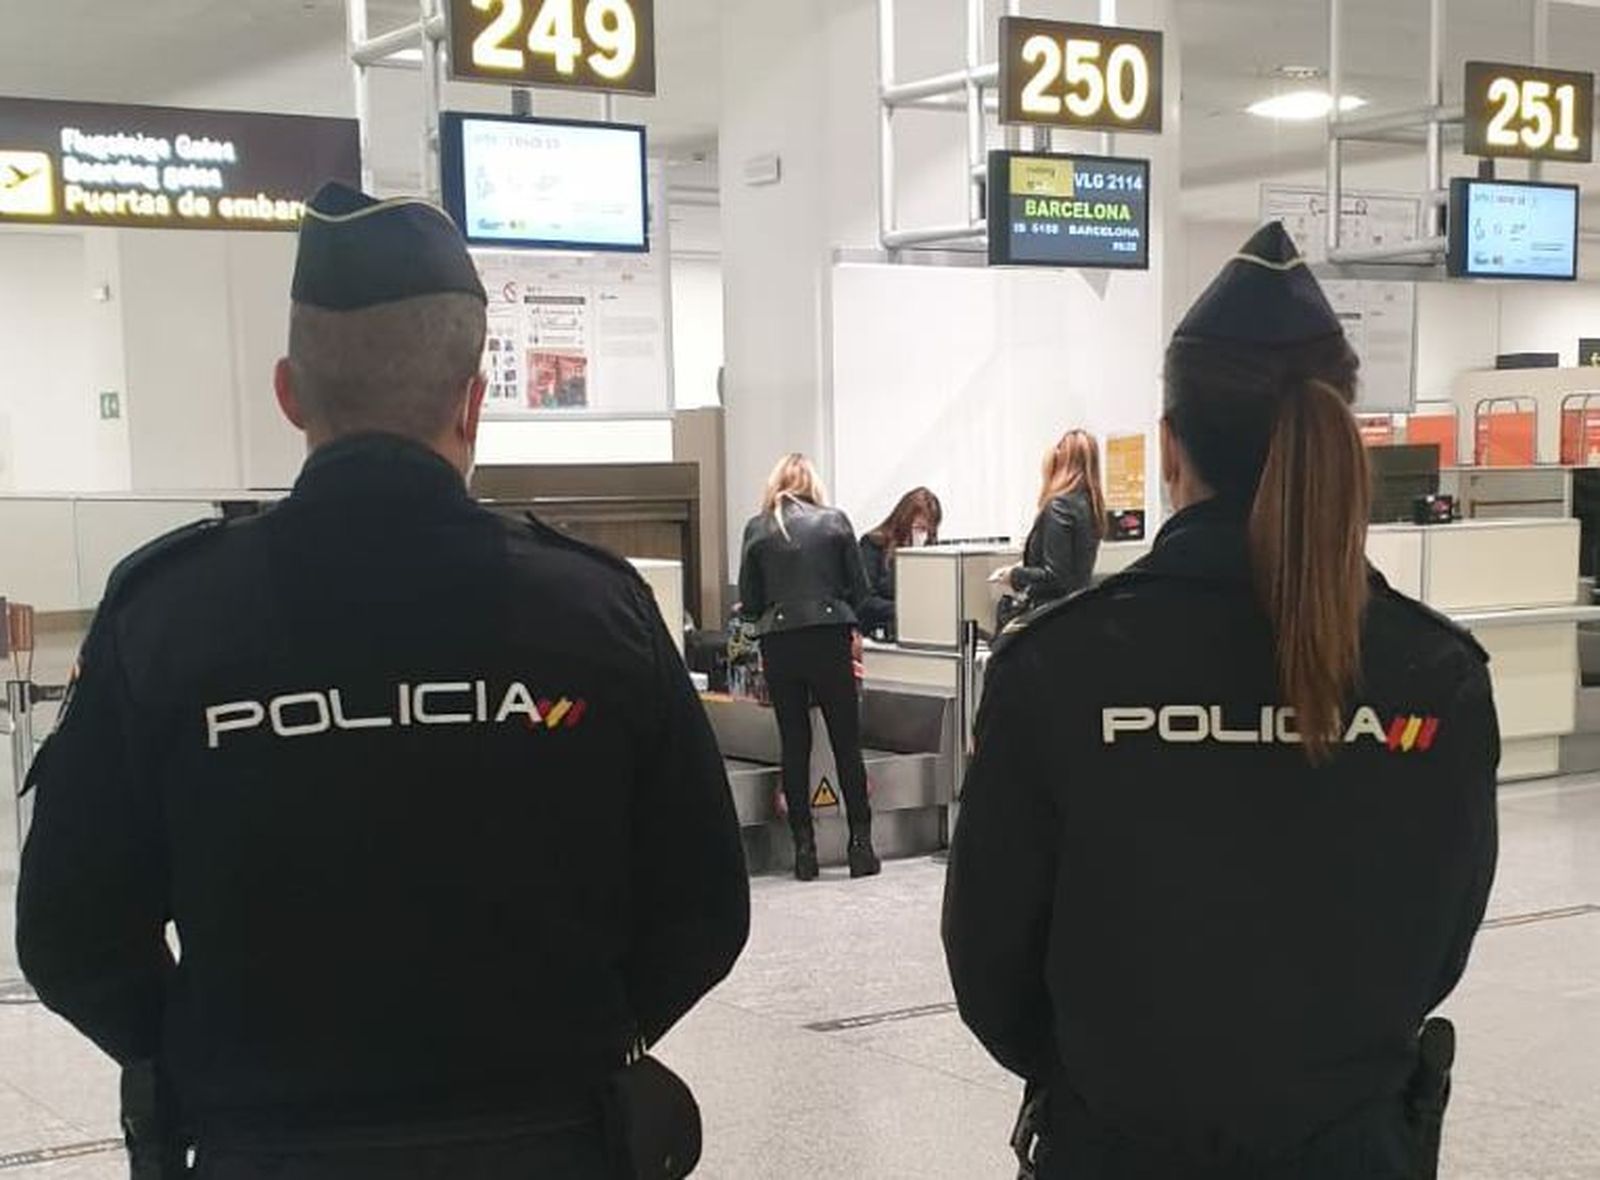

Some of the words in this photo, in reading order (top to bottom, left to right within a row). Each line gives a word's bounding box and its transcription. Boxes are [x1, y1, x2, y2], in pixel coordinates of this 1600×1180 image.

[471, 0, 637, 79] 249
[1021, 35, 1149, 120] 250
[1486, 77, 1579, 151] 251
[1074, 172, 1104, 190] VLG
[1106, 174, 1143, 191] 2114
[64, 184, 170, 216] Puertas
[177, 190, 211, 217] de
[218, 192, 306, 220] embar
[1025, 200, 1131, 220] BARCELONA
[1069, 225, 1140, 238] BARCELONA
[206, 680, 543, 748] POLICIA
[1102, 705, 1388, 743] POLICA
